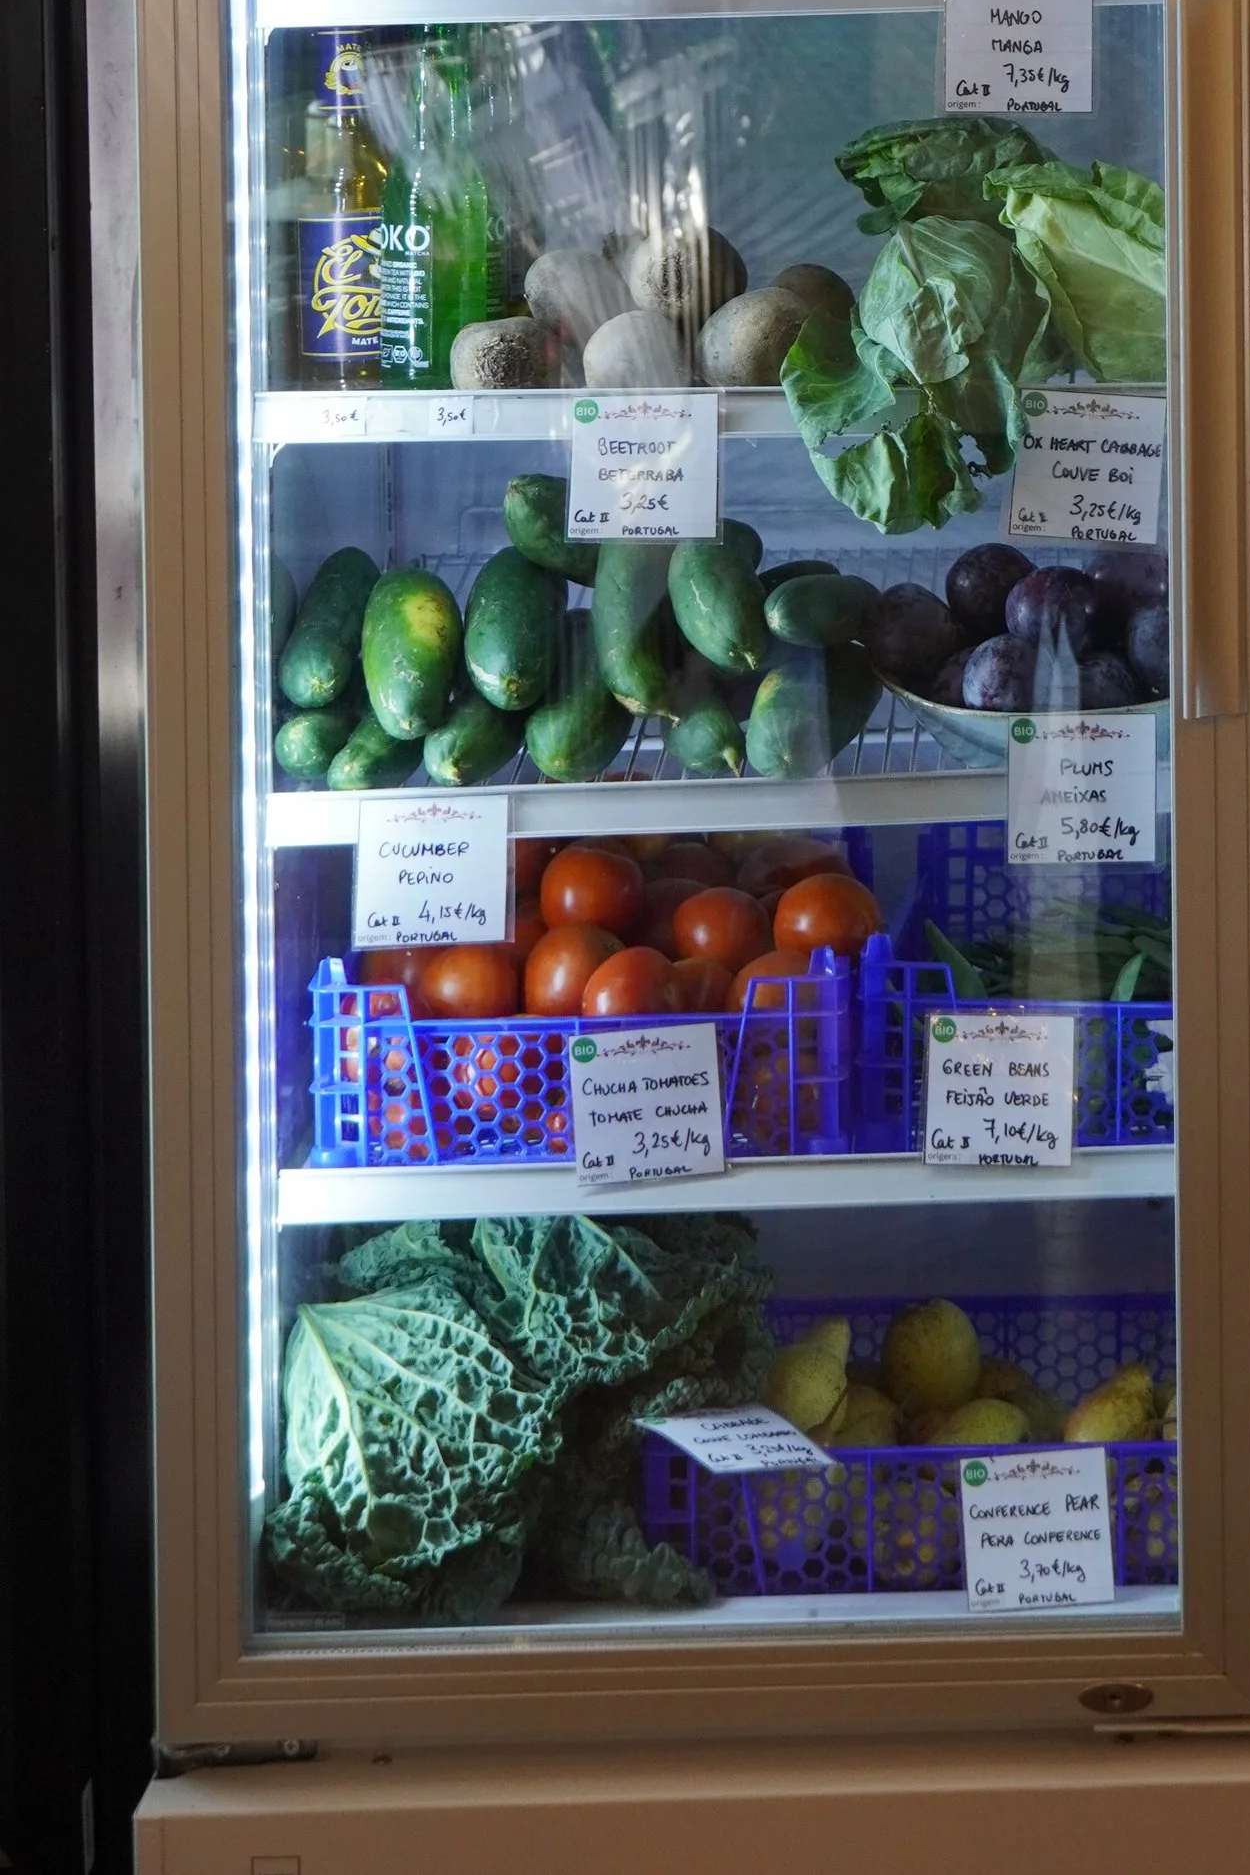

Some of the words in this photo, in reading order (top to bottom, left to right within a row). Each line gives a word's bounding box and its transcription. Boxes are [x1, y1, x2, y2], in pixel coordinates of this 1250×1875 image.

[990, 8, 1042, 26] MANGO
[337, 43, 361, 52] MATE
[992, 40, 1042, 55] MANGA
[352, 337, 378, 345] MATE
[576, 406, 596, 415] BIO
[1026, 400, 1045, 409] BIO
[437, 407, 467, 426] 3,50€
[598, 437, 676, 455] BEETROOT
[1024, 434, 1042, 449] OX
[1051, 437, 1097, 453] HEART
[1101, 438, 1161, 457] CABBAGE
[1052, 461, 1100, 481] COUVE
[574, 510, 595, 522] Cat
[1070, 495, 1141, 525] 3,25€/kg
[622, 526, 679, 535] PORTUGAL
[1071, 526, 1137, 541] PORTUGAL
[1014, 727, 1033, 735] BIO
[1061, 759, 1113, 776] PLUMS
[379, 842, 469, 858] CUCUMBER
[1058, 849, 1124, 862] PORTUGAL
[397, 931, 458, 942] PORTUGAL
[935, 1026, 954, 1035] BIO
[574, 1045, 594, 1054] BIO
[943, 1059, 993, 1077] GREEN
[1009, 1062, 1050, 1077] BEANS
[582, 1077, 637, 1096] CHUCHA
[642, 1072, 709, 1090] TOMATOES
[1004, 1090, 1050, 1106] VERDE
[589, 1109, 643, 1126] TOMATE
[656, 1101, 708, 1117] CHUCHA
[932, 1128, 955, 1149] Cat
[630, 1164, 692, 1180] PORTUGAL
[966, 1470, 985, 1479] BIO
[970, 1502, 1050, 1519] CONFERENCE
[1066, 1494, 1101, 1512] PEAR
[981, 1532, 1014, 1549] PERA
[1024, 1529, 1101, 1545] CONFERENCE
[1019, 1593, 1076, 1604] PORTUGAL
